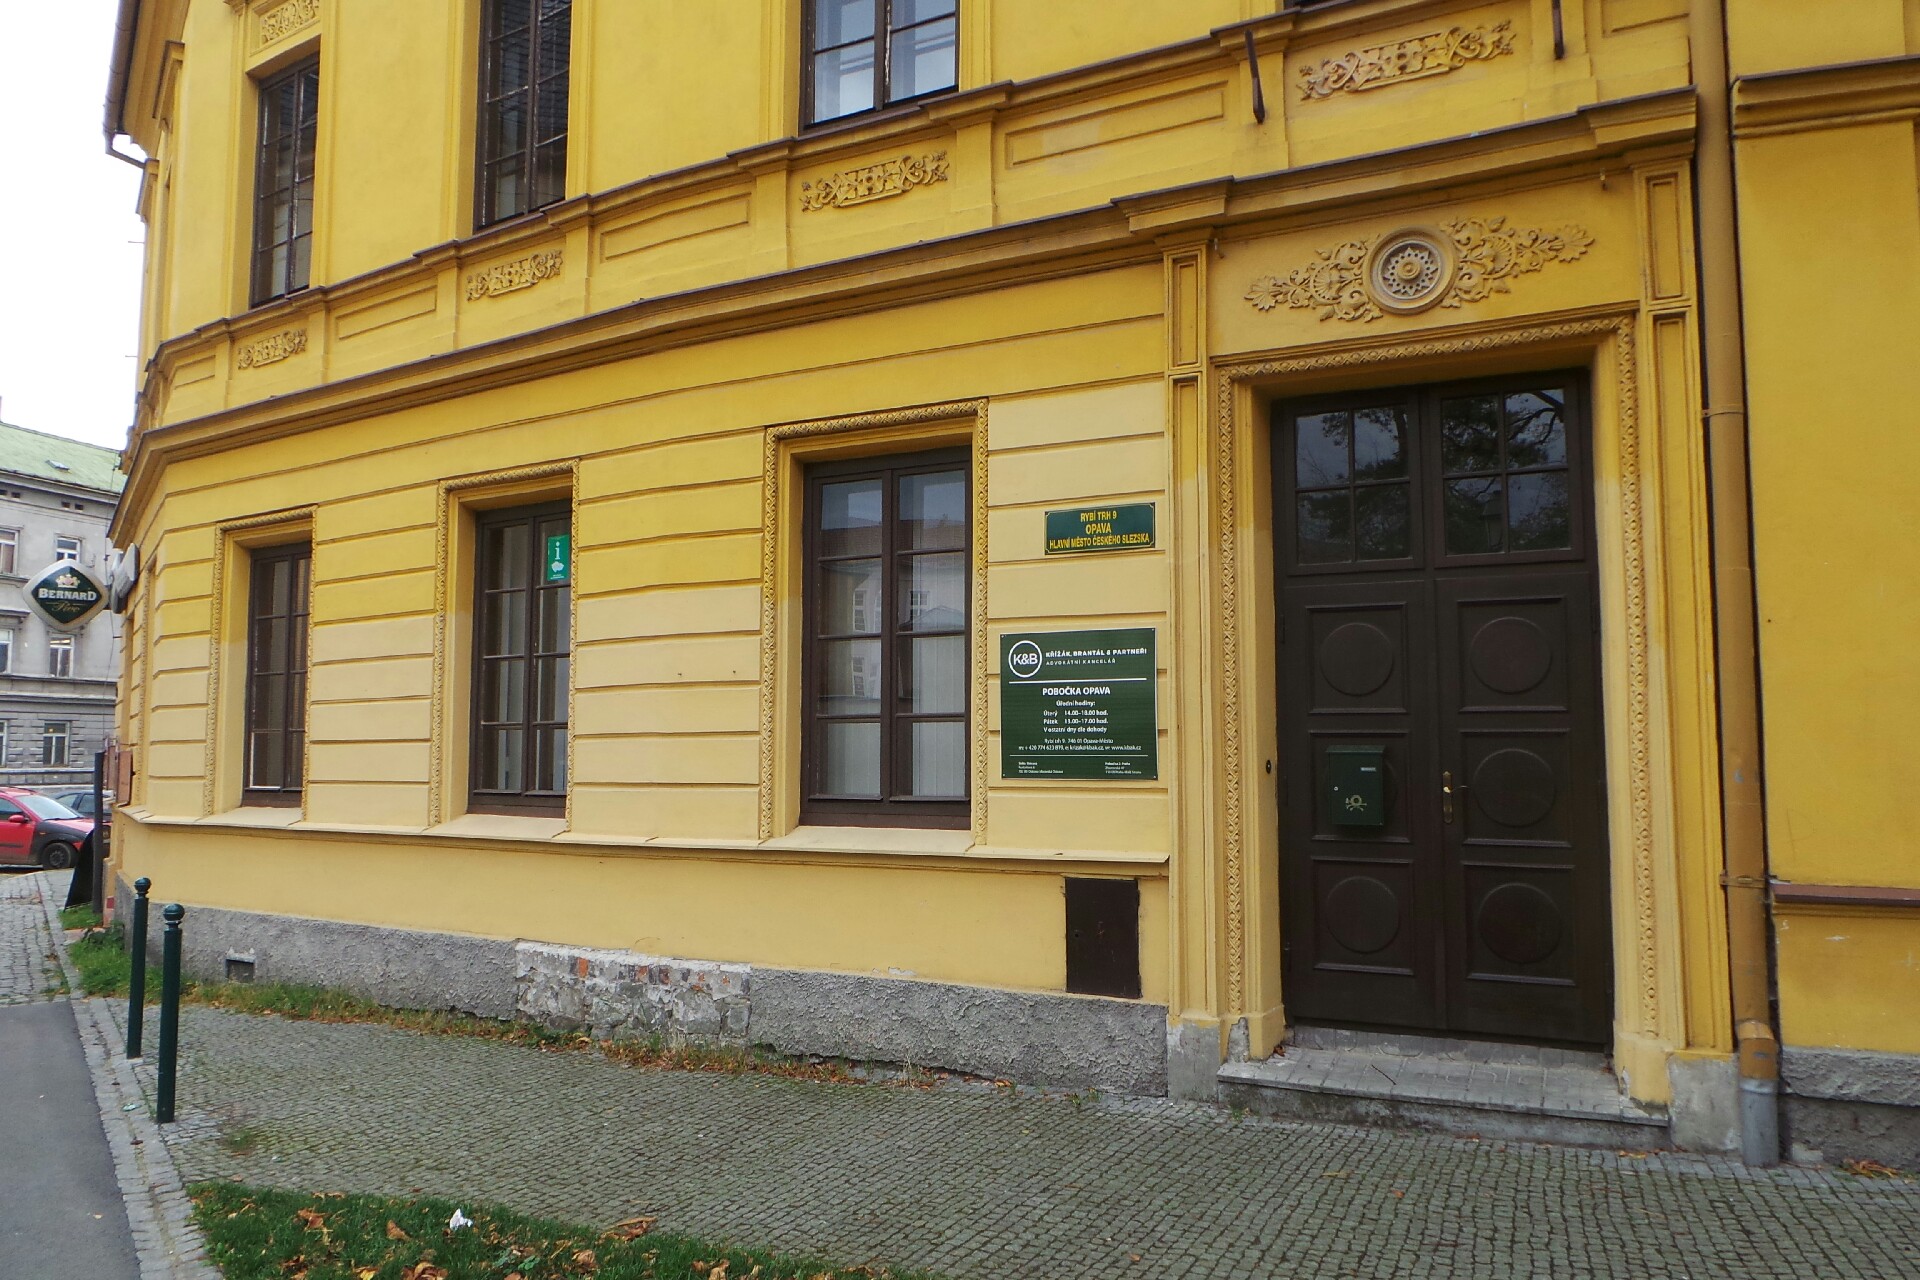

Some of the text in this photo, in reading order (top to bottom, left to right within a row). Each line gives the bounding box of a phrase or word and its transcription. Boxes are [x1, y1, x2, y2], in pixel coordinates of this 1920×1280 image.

[1080, 510, 1117, 522] RYBÍ TRH 9
[1085, 522, 1112, 535] OPAVA
[1049, 533, 1150, 549] HLAVNÍ MĚSTO ČESKÉHO SLEZSKA
[38, 588, 97, 601] BERNARD
[1013, 653, 1038, 665] K&B
[1082, 657, 1116, 665] KANCELÁŘ
[1042, 686, 1111, 696] POBOČKA OPAVA
[1055, 699, 1096, 708] Úřední hodiny:
[1043, 709, 1058, 717] Úterý
[1086, 726, 1107, 734] dohody
